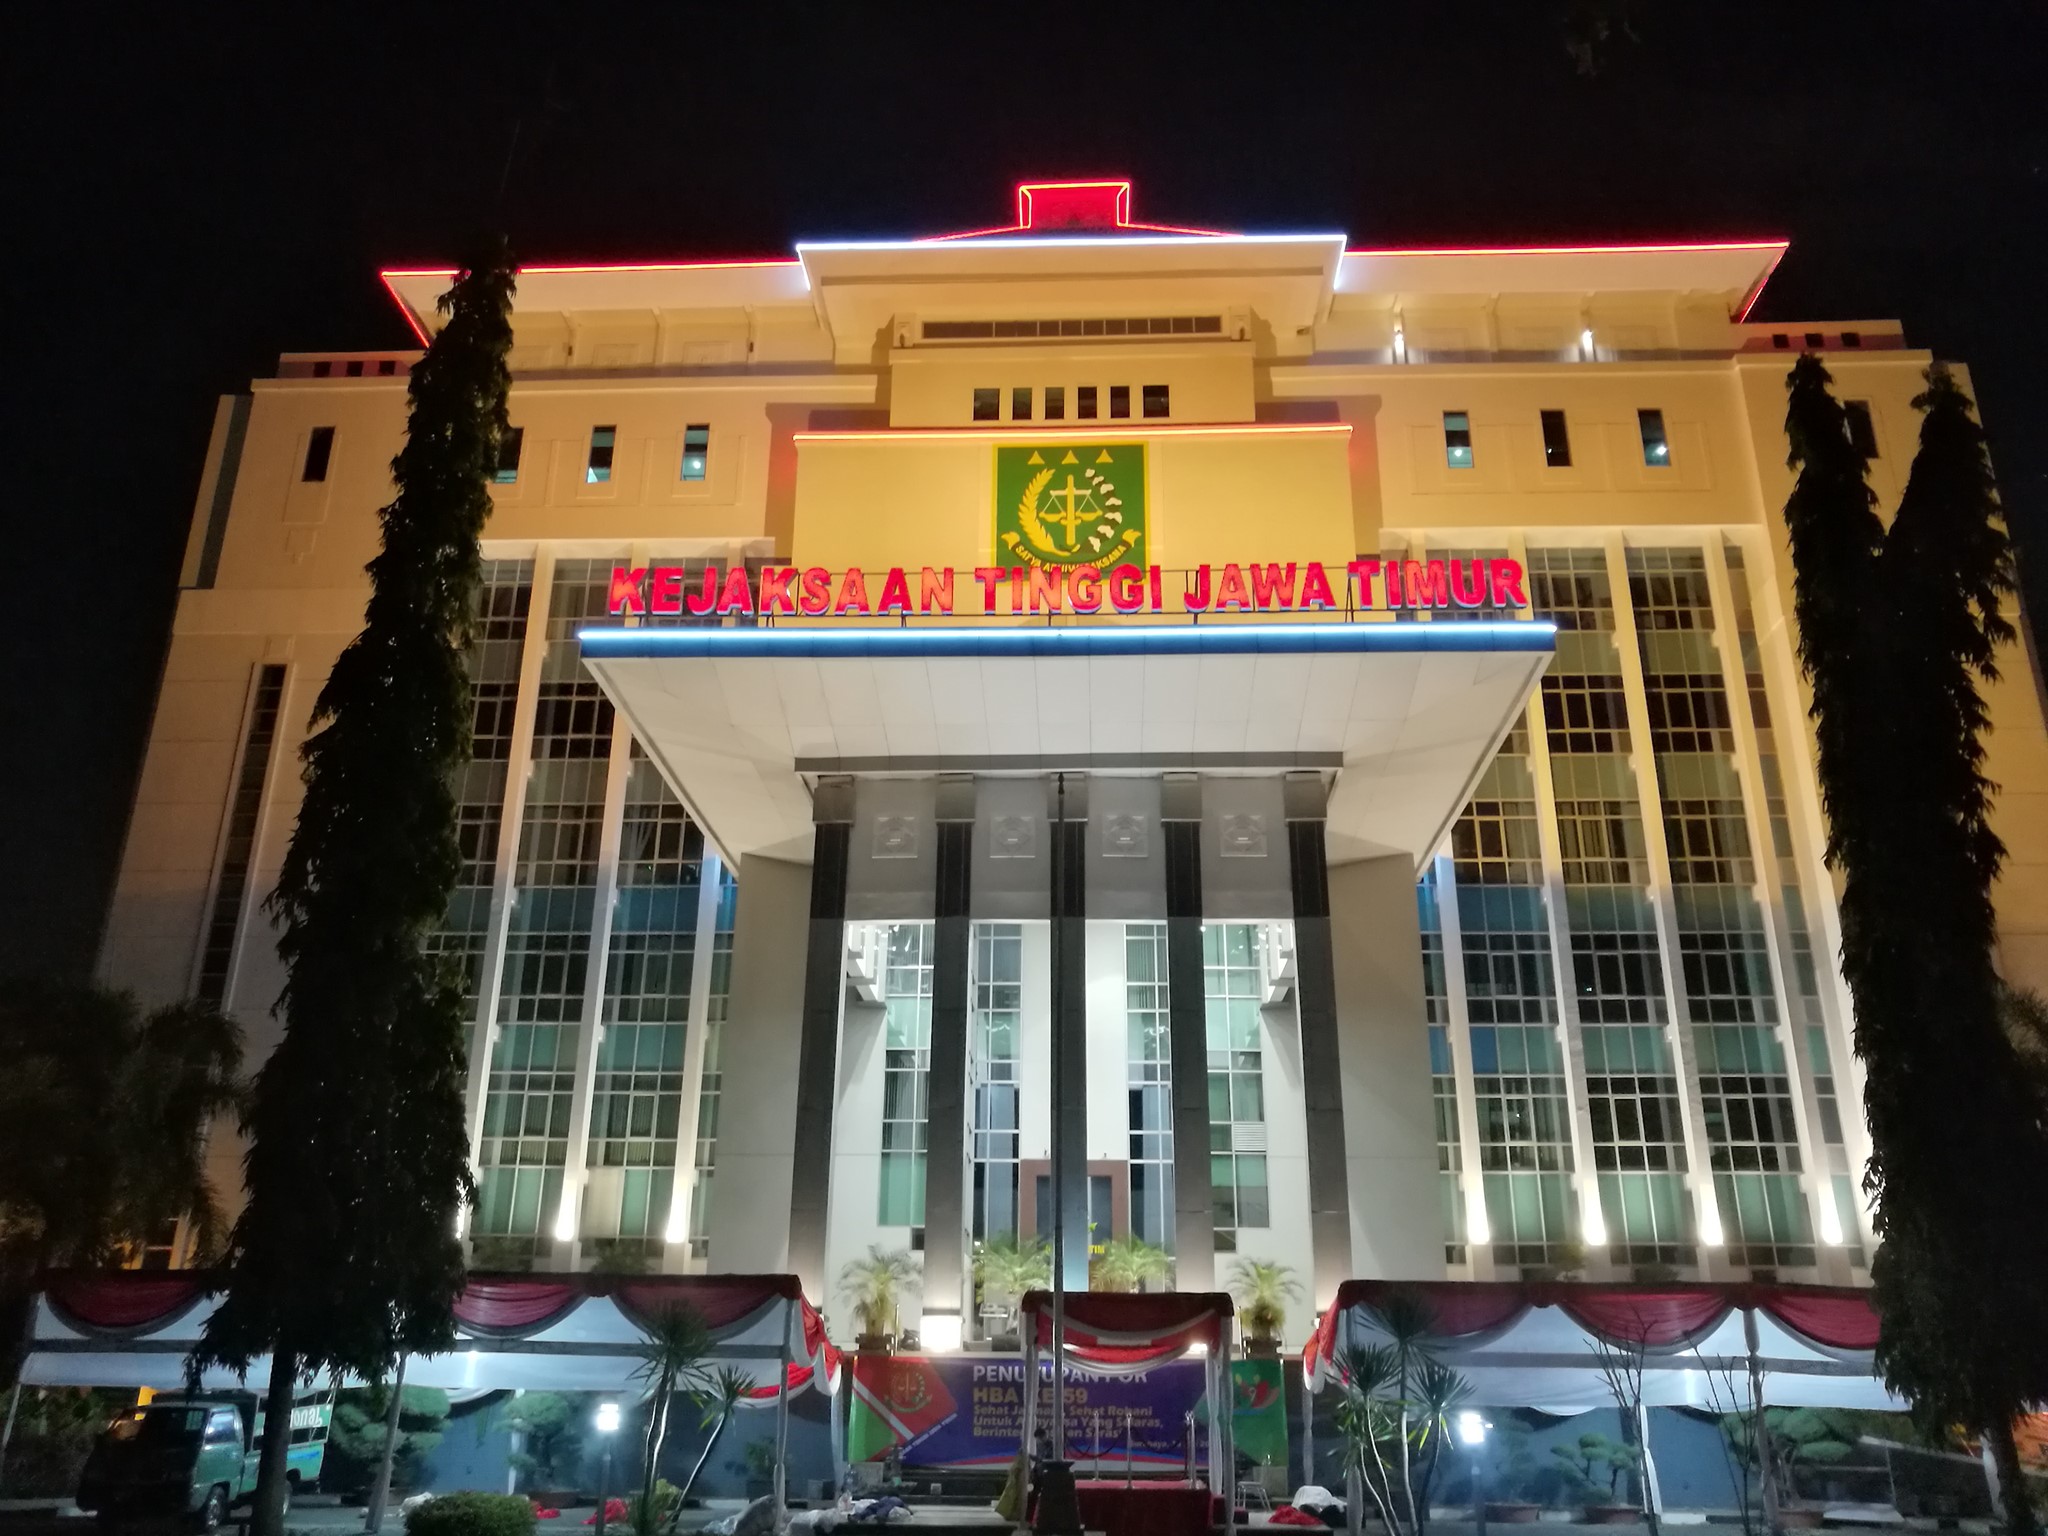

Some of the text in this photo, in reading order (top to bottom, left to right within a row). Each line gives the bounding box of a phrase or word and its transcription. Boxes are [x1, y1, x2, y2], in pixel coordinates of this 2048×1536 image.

[1015, 545, 1041, 567] SATYA
[608, 558, 1529, 616] KEJAKSAAN TINGGI JAWA TIMUR
[973, 1365, 1100, 1383] PENUUPAN
[973, 1387, 1018, 1403] HBA
[1063, 1387, 1088, 1404] 59
[974, 1405, 1009, 1416] Sehat
[1070, 1405, 1105, 1417] Sehat
[974, 1416, 1013, 1427] Untuk
[1081, 1416, 1113, 1429] Yang
